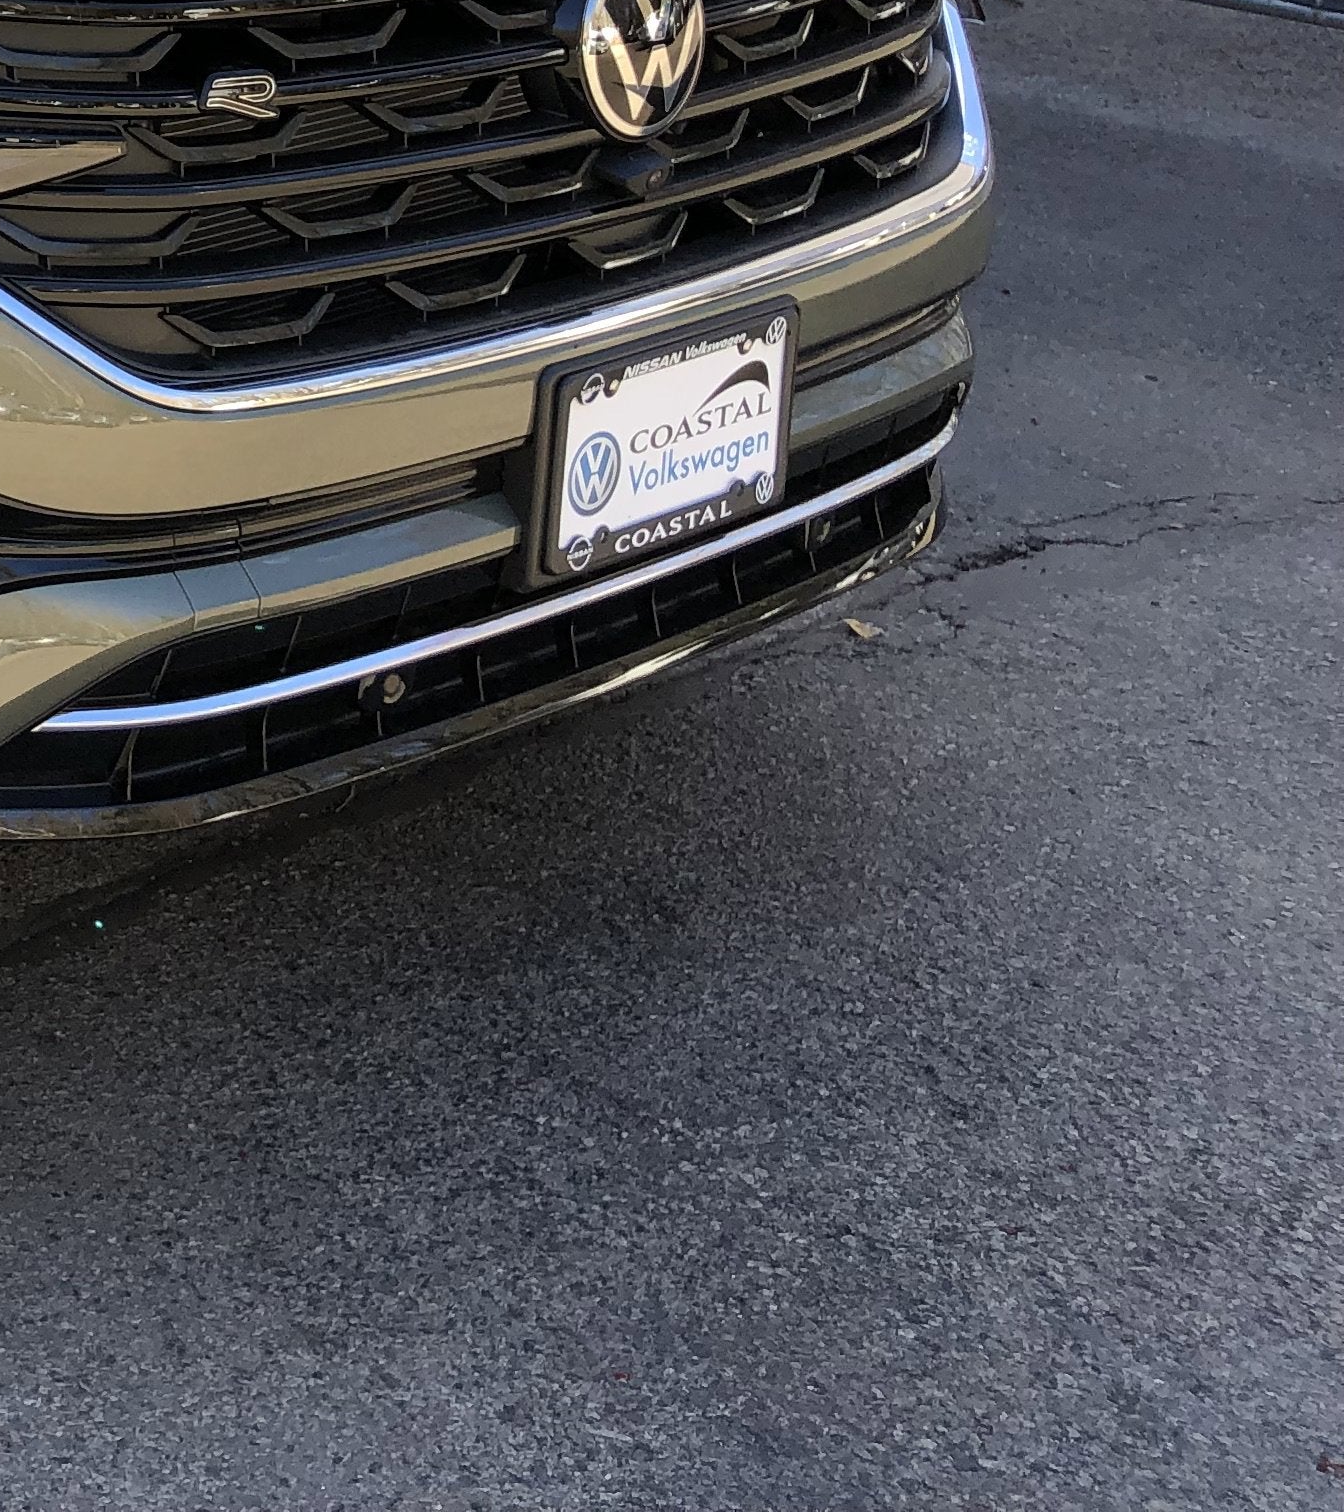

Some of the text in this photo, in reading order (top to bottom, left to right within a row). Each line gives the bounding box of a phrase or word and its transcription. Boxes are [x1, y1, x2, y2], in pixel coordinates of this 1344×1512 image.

[622, 332, 747, 380] NISSAN Volkswagen
[629, 390, 772, 455] COASTAL
[629, 430, 770, 496] Volkswagen
[614, 499, 733, 555] COASTAL
